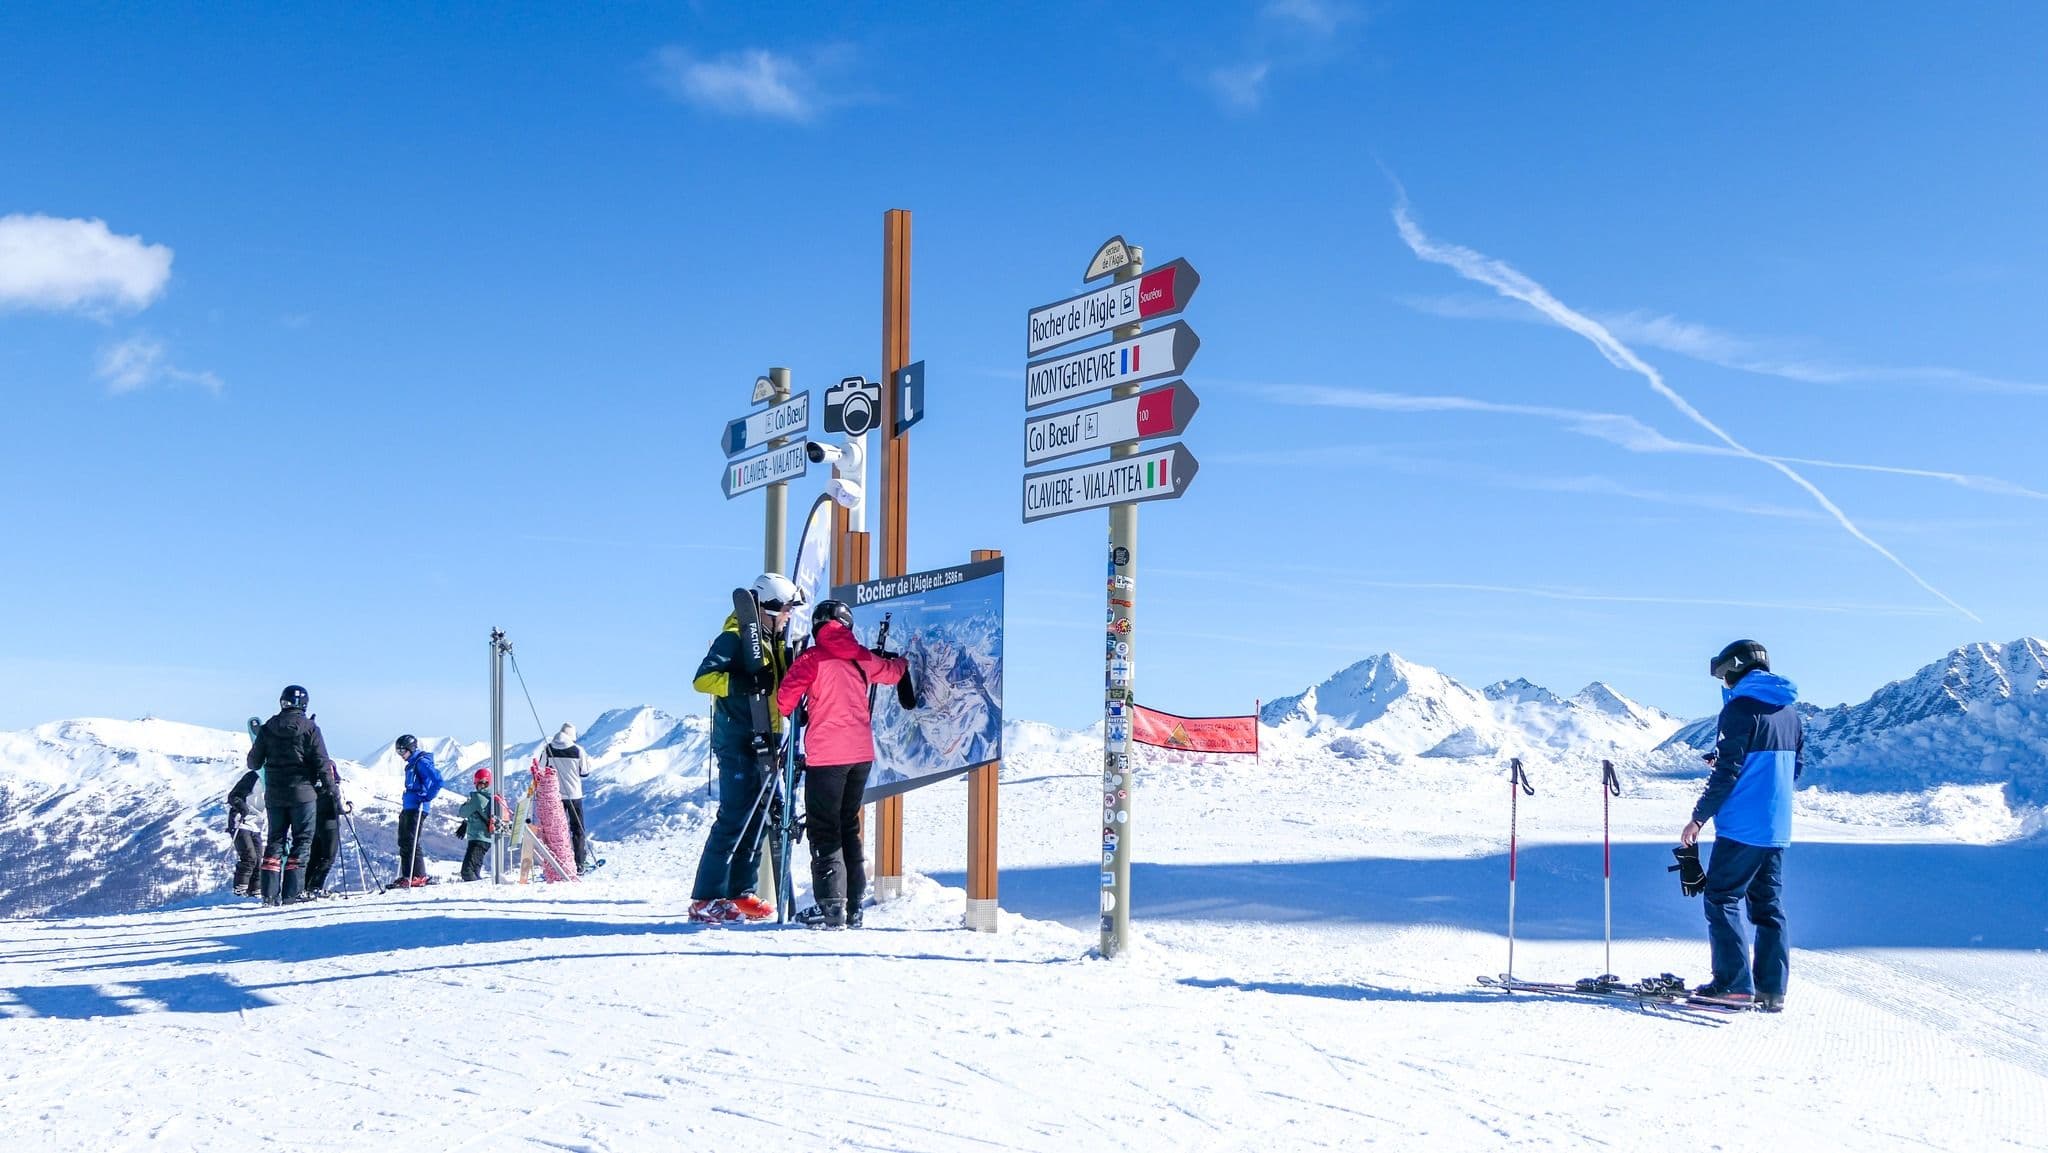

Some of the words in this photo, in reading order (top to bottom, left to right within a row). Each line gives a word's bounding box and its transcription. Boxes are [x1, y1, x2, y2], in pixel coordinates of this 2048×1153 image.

[1032, 313, 1065, 343] Rocher
[1067, 304, 1081, 332] de
[1083, 292, 1116, 328] l'Aigle
[1030, 351, 1115, 398] MONTGENEVRE
[775, 407, 786, 430] Col
[787, 398, 807, 426] Bœuf
[1138, 409, 1149, 422] 100
[1029, 424, 1045, 452] Col
[1049, 415, 1081, 449] Bœuf
[743, 458, 769, 485] CLAVIERE
[772, 446, 804, 476] VIALATTEA
[1027, 476, 1074, 511] CLAVIERE
[1083, 463, 1142, 501] VIALATTEA
[857, 580, 897, 605] Rocher
[897, 578, 909, 595] de
[910, 574, 933, 593] l'Aigle
[933, 572, 944, 587] alt.
[748, 622, 761, 660] FACTION
